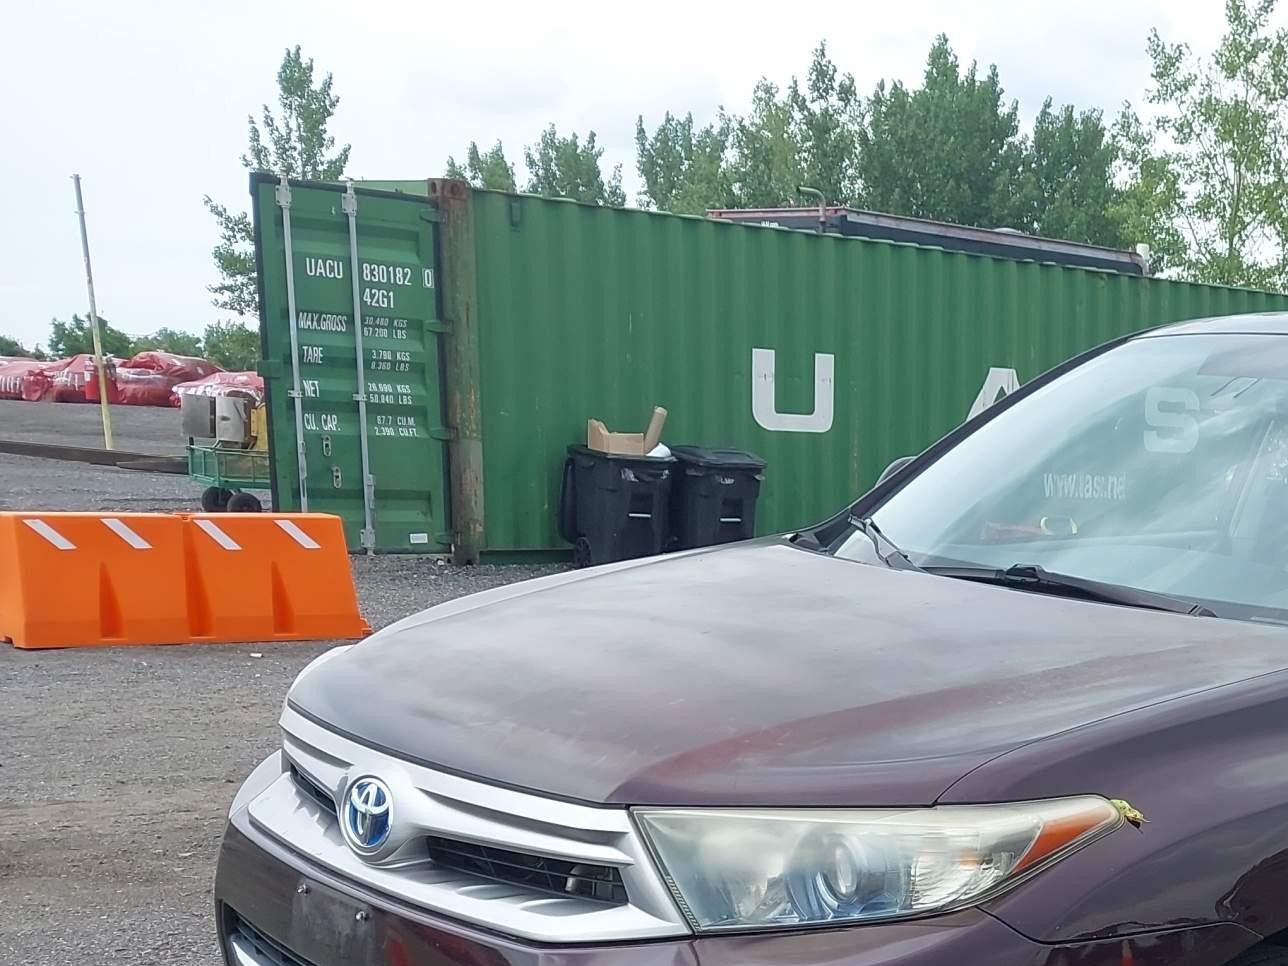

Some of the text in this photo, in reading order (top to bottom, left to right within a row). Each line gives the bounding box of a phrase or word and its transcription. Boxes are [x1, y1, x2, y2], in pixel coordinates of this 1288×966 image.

[305, 257, 433, 287] UACU 830182 0
[363, 287, 394, 309] 42G1
[298, 311, 347, 332] MAX.GROSS
[393, 319, 408, 328] KGS
[302, 345, 323, 364] TARE
[396, 351, 410, 361] KGS
[395, 362, 410, 372] LBS
[302, 379, 320, 398] NET
[396, 384, 411, 394] KGS
[398, 394, 412, 405] LBS
